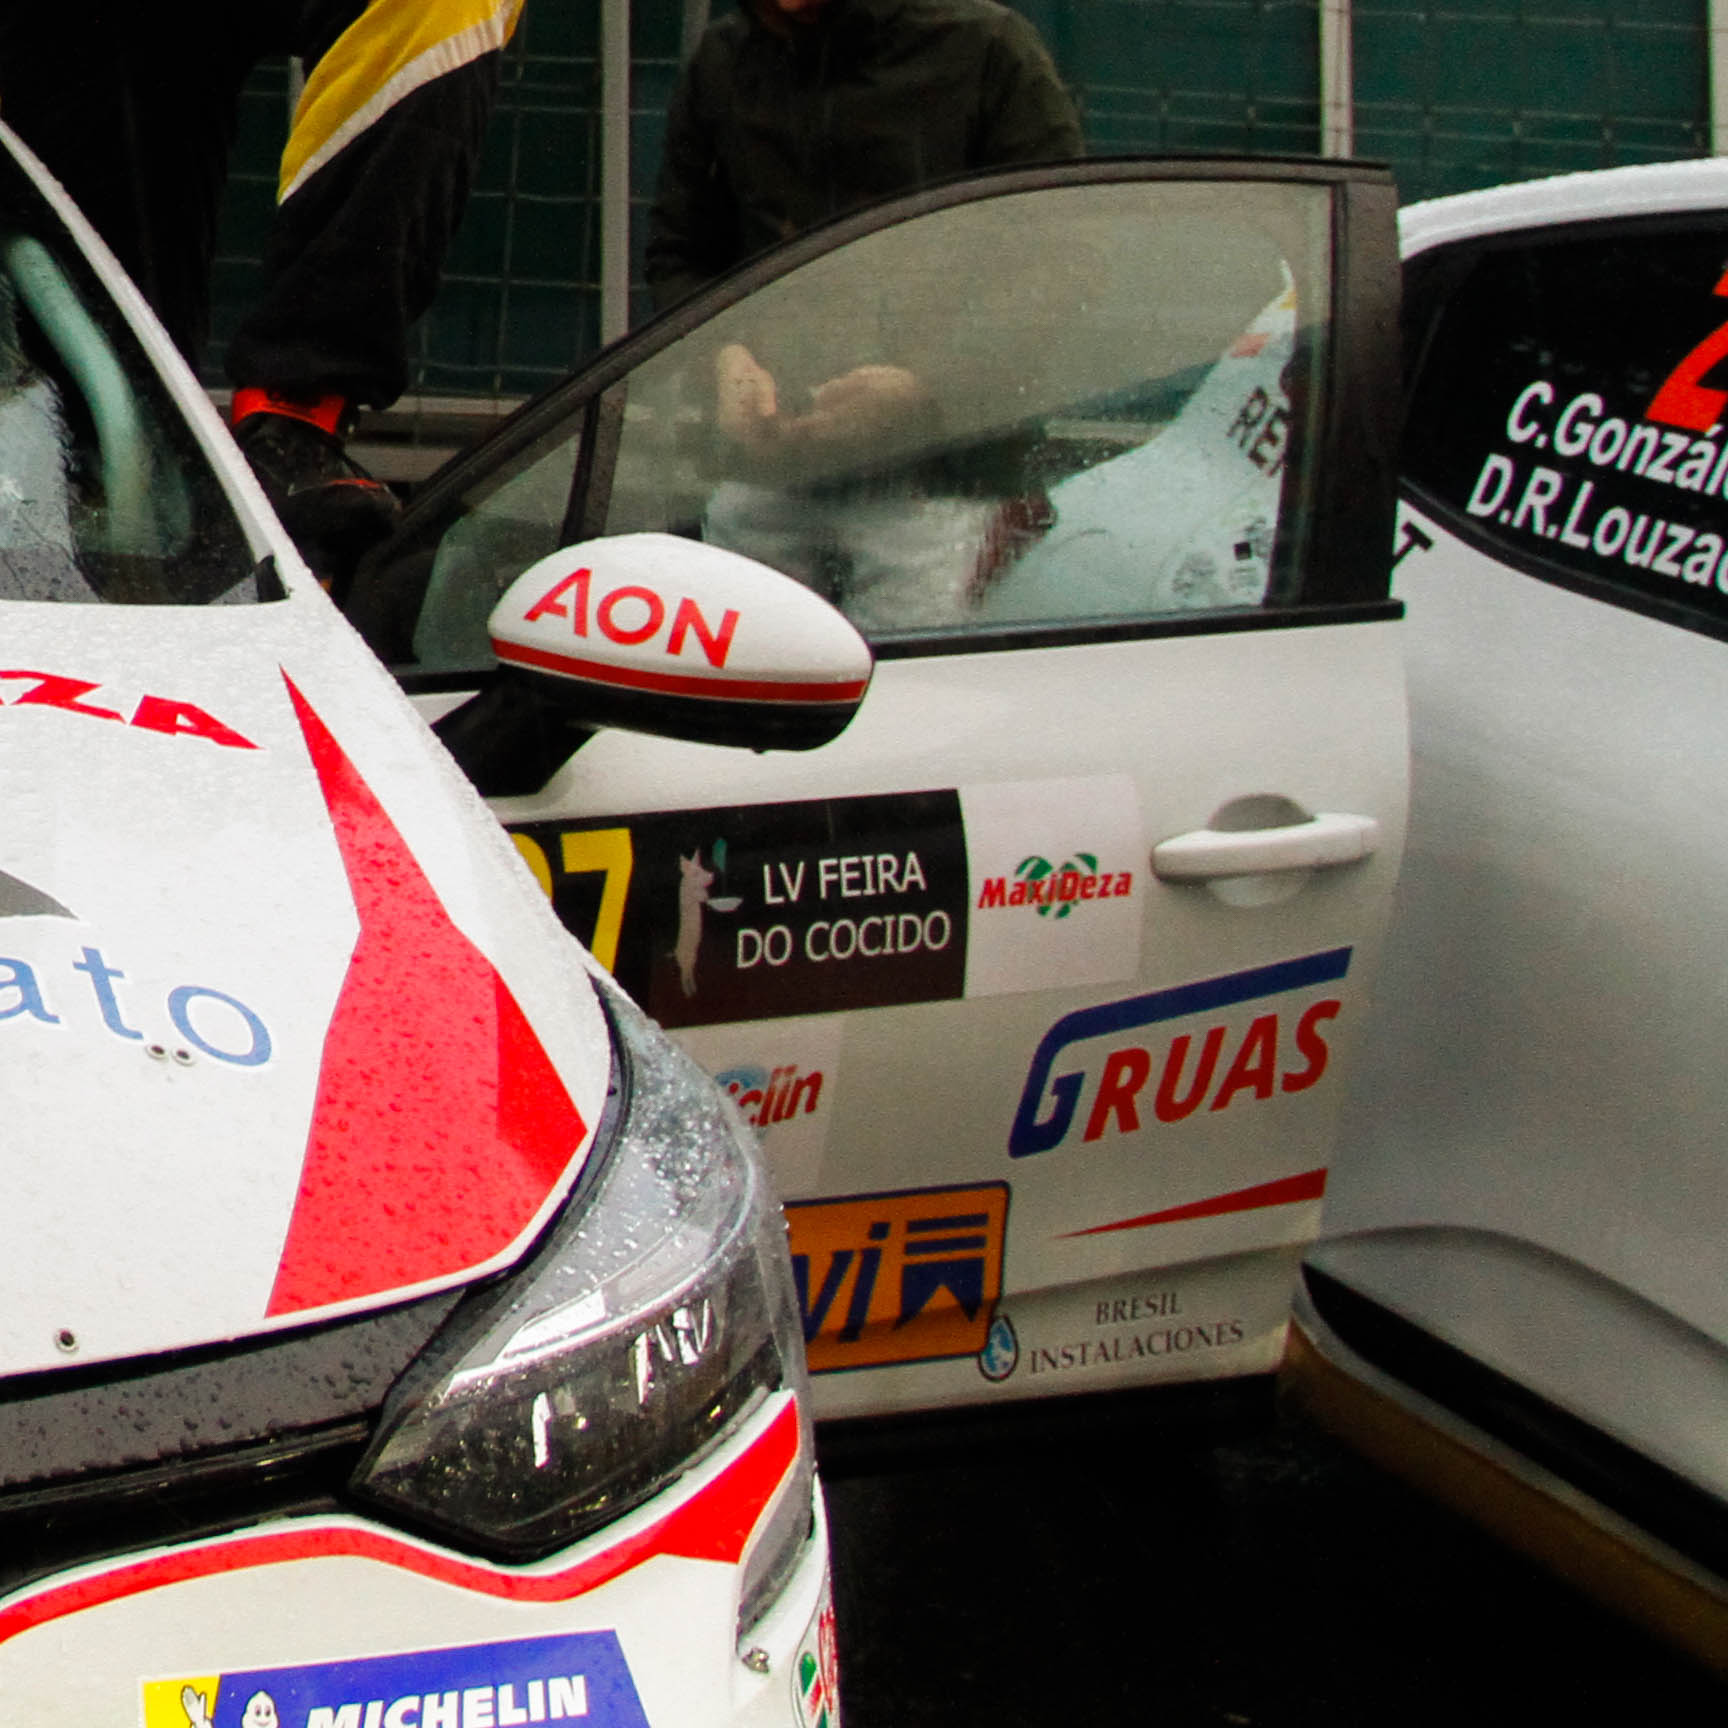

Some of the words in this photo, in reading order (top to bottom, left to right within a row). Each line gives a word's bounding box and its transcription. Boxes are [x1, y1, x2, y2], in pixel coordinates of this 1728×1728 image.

[1506, 380, 1728, 502] C.Gonzál
[523, 567, 741, 669] AON
[762, 860, 806, 905] LV
[817, 851, 927, 900] FEIRA
[977, 871, 1133, 910] MaxiDeza
[735, 926, 793, 970] DO
[803, 909, 952, 963] COCIDO
[1007, 960, 1346, 1160] GRUAS
[1095, 1292, 1183, 1328] BRESIL
[1029, 1318, 1244, 1374] INSTALACIONES
[305, 1674, 589, 1728] MICHELIN
